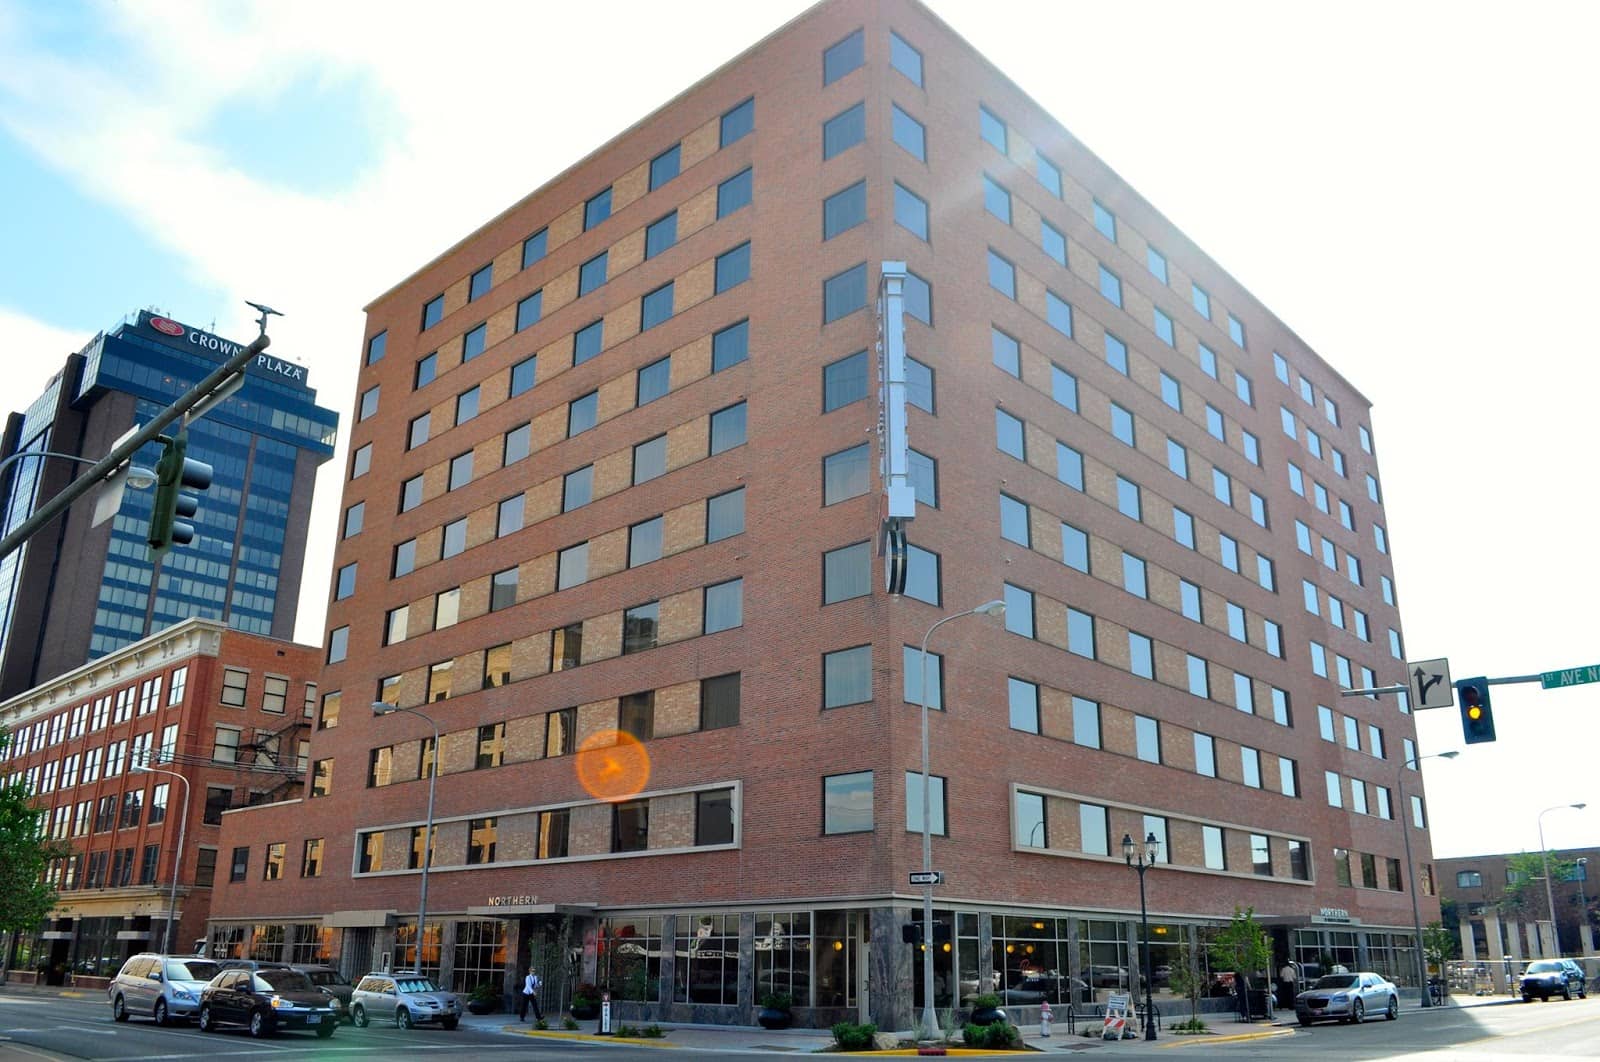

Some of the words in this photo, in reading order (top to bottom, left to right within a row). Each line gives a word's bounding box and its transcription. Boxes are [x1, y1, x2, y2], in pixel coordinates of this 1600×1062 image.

[189, 331, 243, 358] CROWN
[257, 354, 302, 381] PLAZA
[1560, 669, 1585, 686] AVE
[1587, 665, 1600, 682] N
[488, 895, 538, 906] NORTHERN
